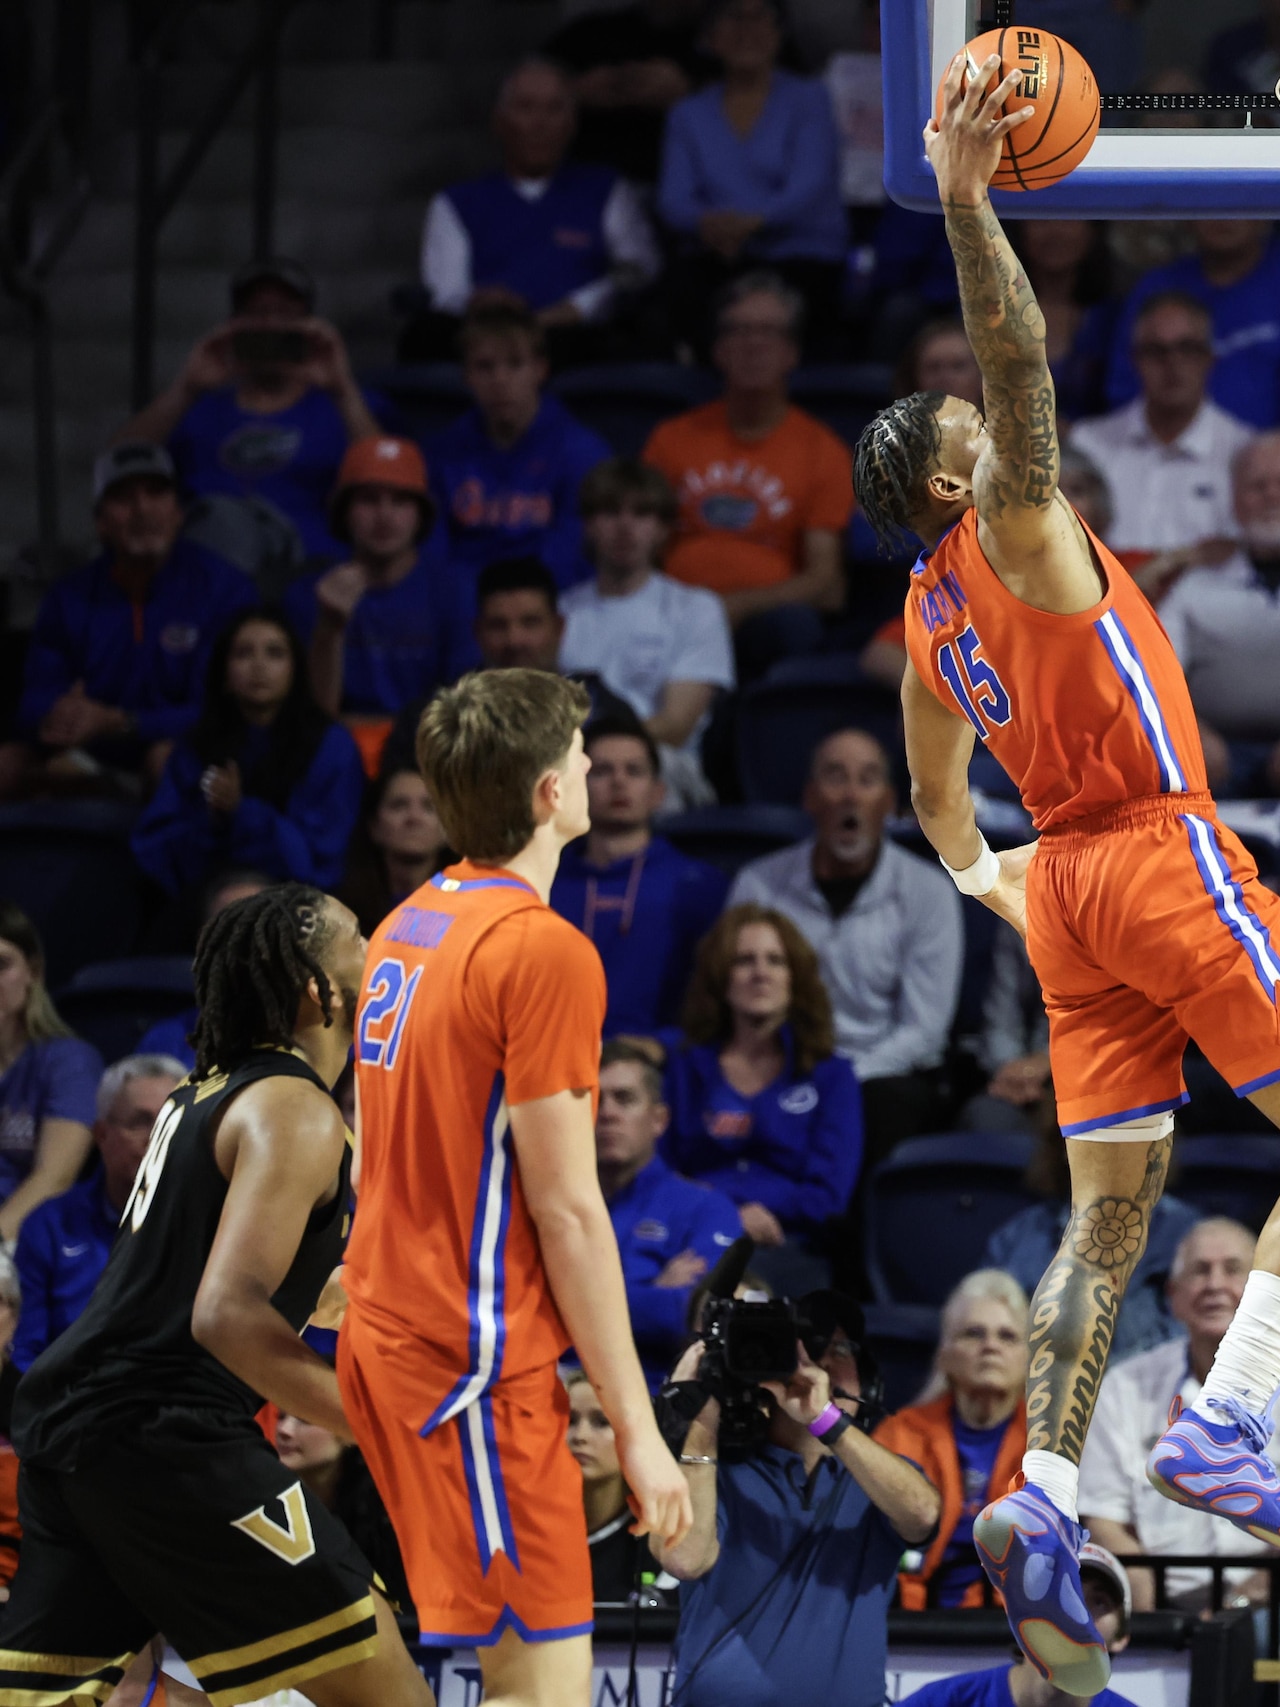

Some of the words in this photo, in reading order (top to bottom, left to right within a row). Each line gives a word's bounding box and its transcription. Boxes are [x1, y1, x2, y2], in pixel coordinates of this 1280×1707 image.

[1014, 31, 1041, 99] ELITE
[1024, 387, 1056, 507] FEARLESS
[937, 622, 1013, 741] 15
[358, 957, 425, 1072] 21
[228, 1480, 316, 1567] V
